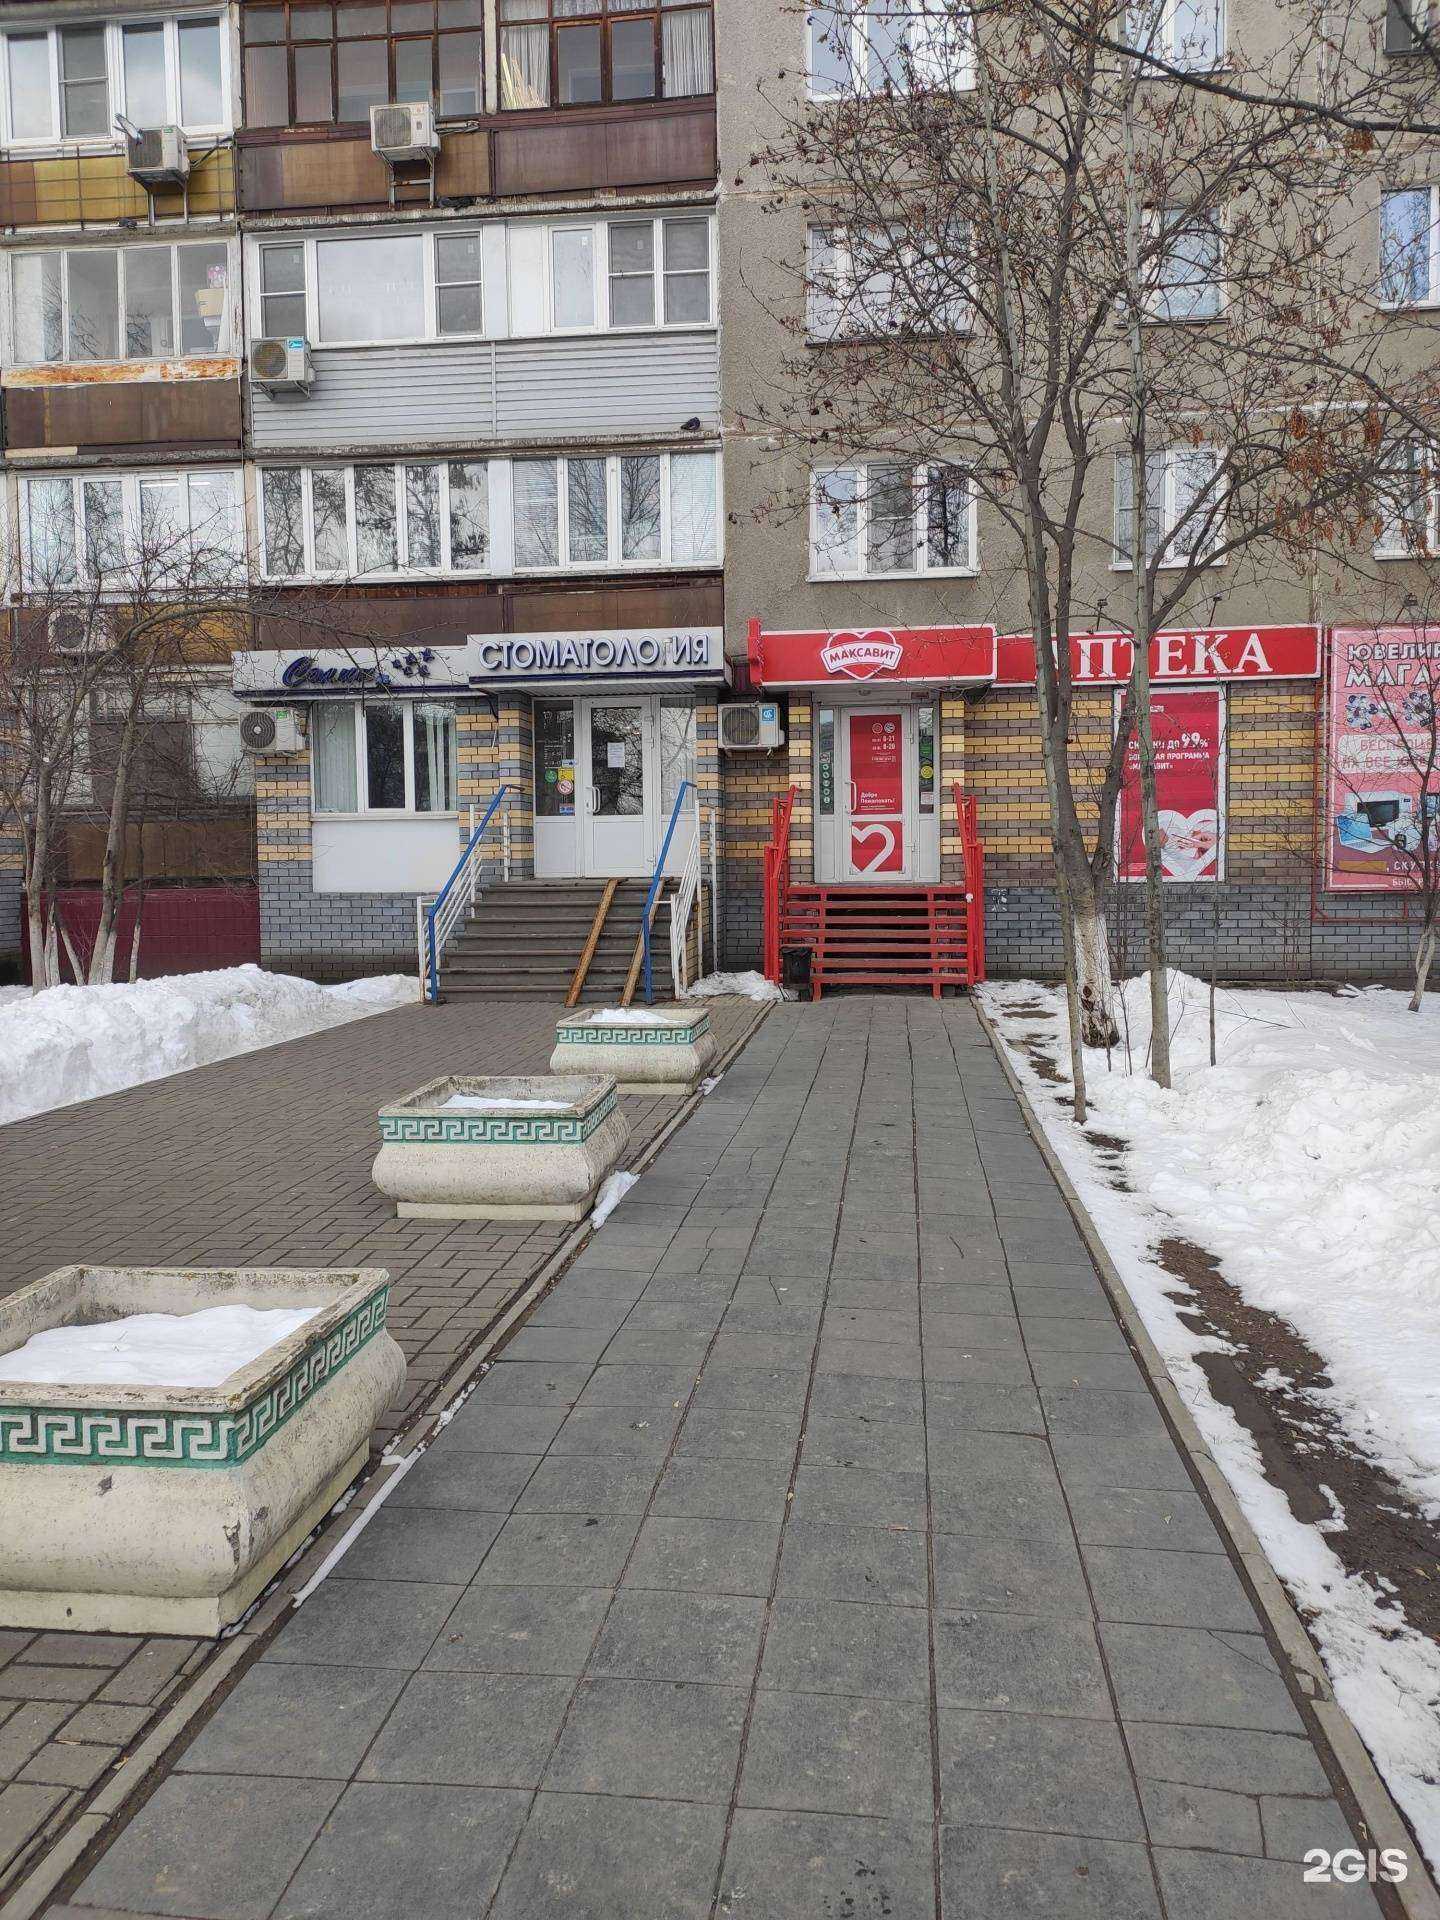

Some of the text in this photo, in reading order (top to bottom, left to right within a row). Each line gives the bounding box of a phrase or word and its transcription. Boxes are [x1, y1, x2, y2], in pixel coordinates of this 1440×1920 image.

[478, 634, 709, 669] СТОМАТОЛОГИЯ
[829, 647, 895, 663] МАКСАВИТ
[1034, 633, 1273, 680] ПЕКА
[1128, 740, 1165, 750] СККИ
